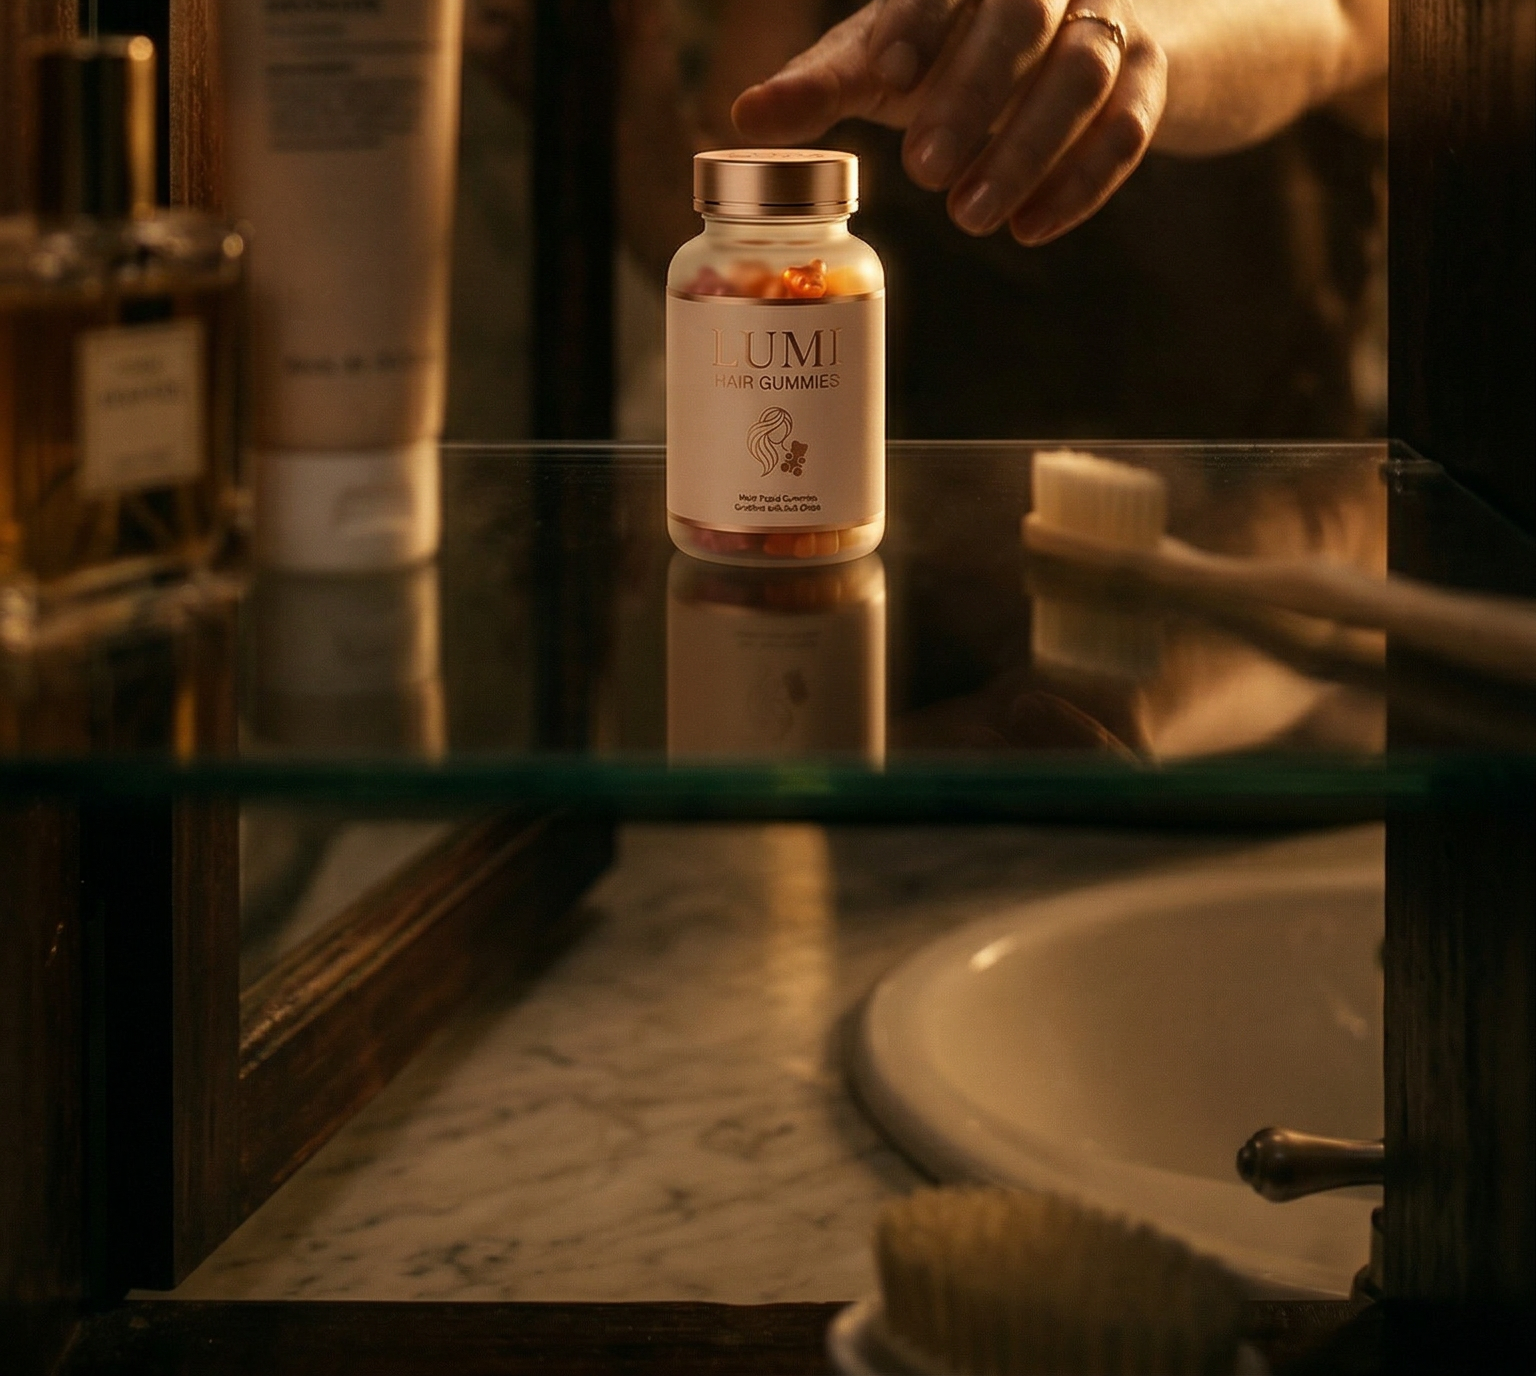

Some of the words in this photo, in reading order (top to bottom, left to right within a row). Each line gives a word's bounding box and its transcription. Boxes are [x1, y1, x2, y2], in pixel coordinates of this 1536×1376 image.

[712, 327, 843, 369] LUMI
[715, 374, 754, 390] HAIR
[758, 374, 841, 391] GUMMIES
